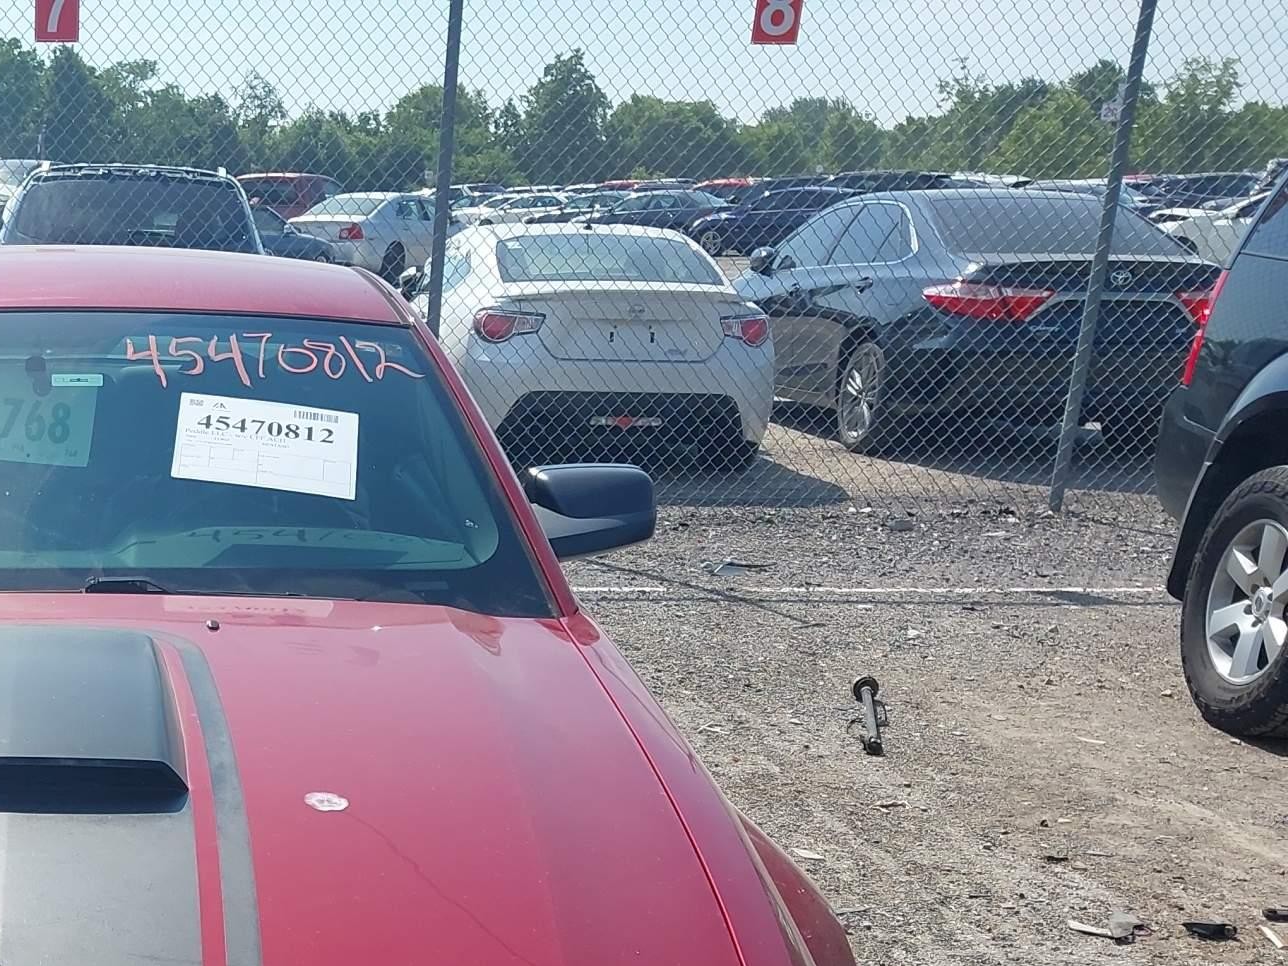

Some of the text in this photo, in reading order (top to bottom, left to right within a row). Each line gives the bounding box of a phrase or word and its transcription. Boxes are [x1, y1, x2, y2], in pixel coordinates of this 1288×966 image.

[126, 332, 426, 389] 45470812
[0, 398, 72, 444] 768
[196, 414, 335, 444] 45470812
